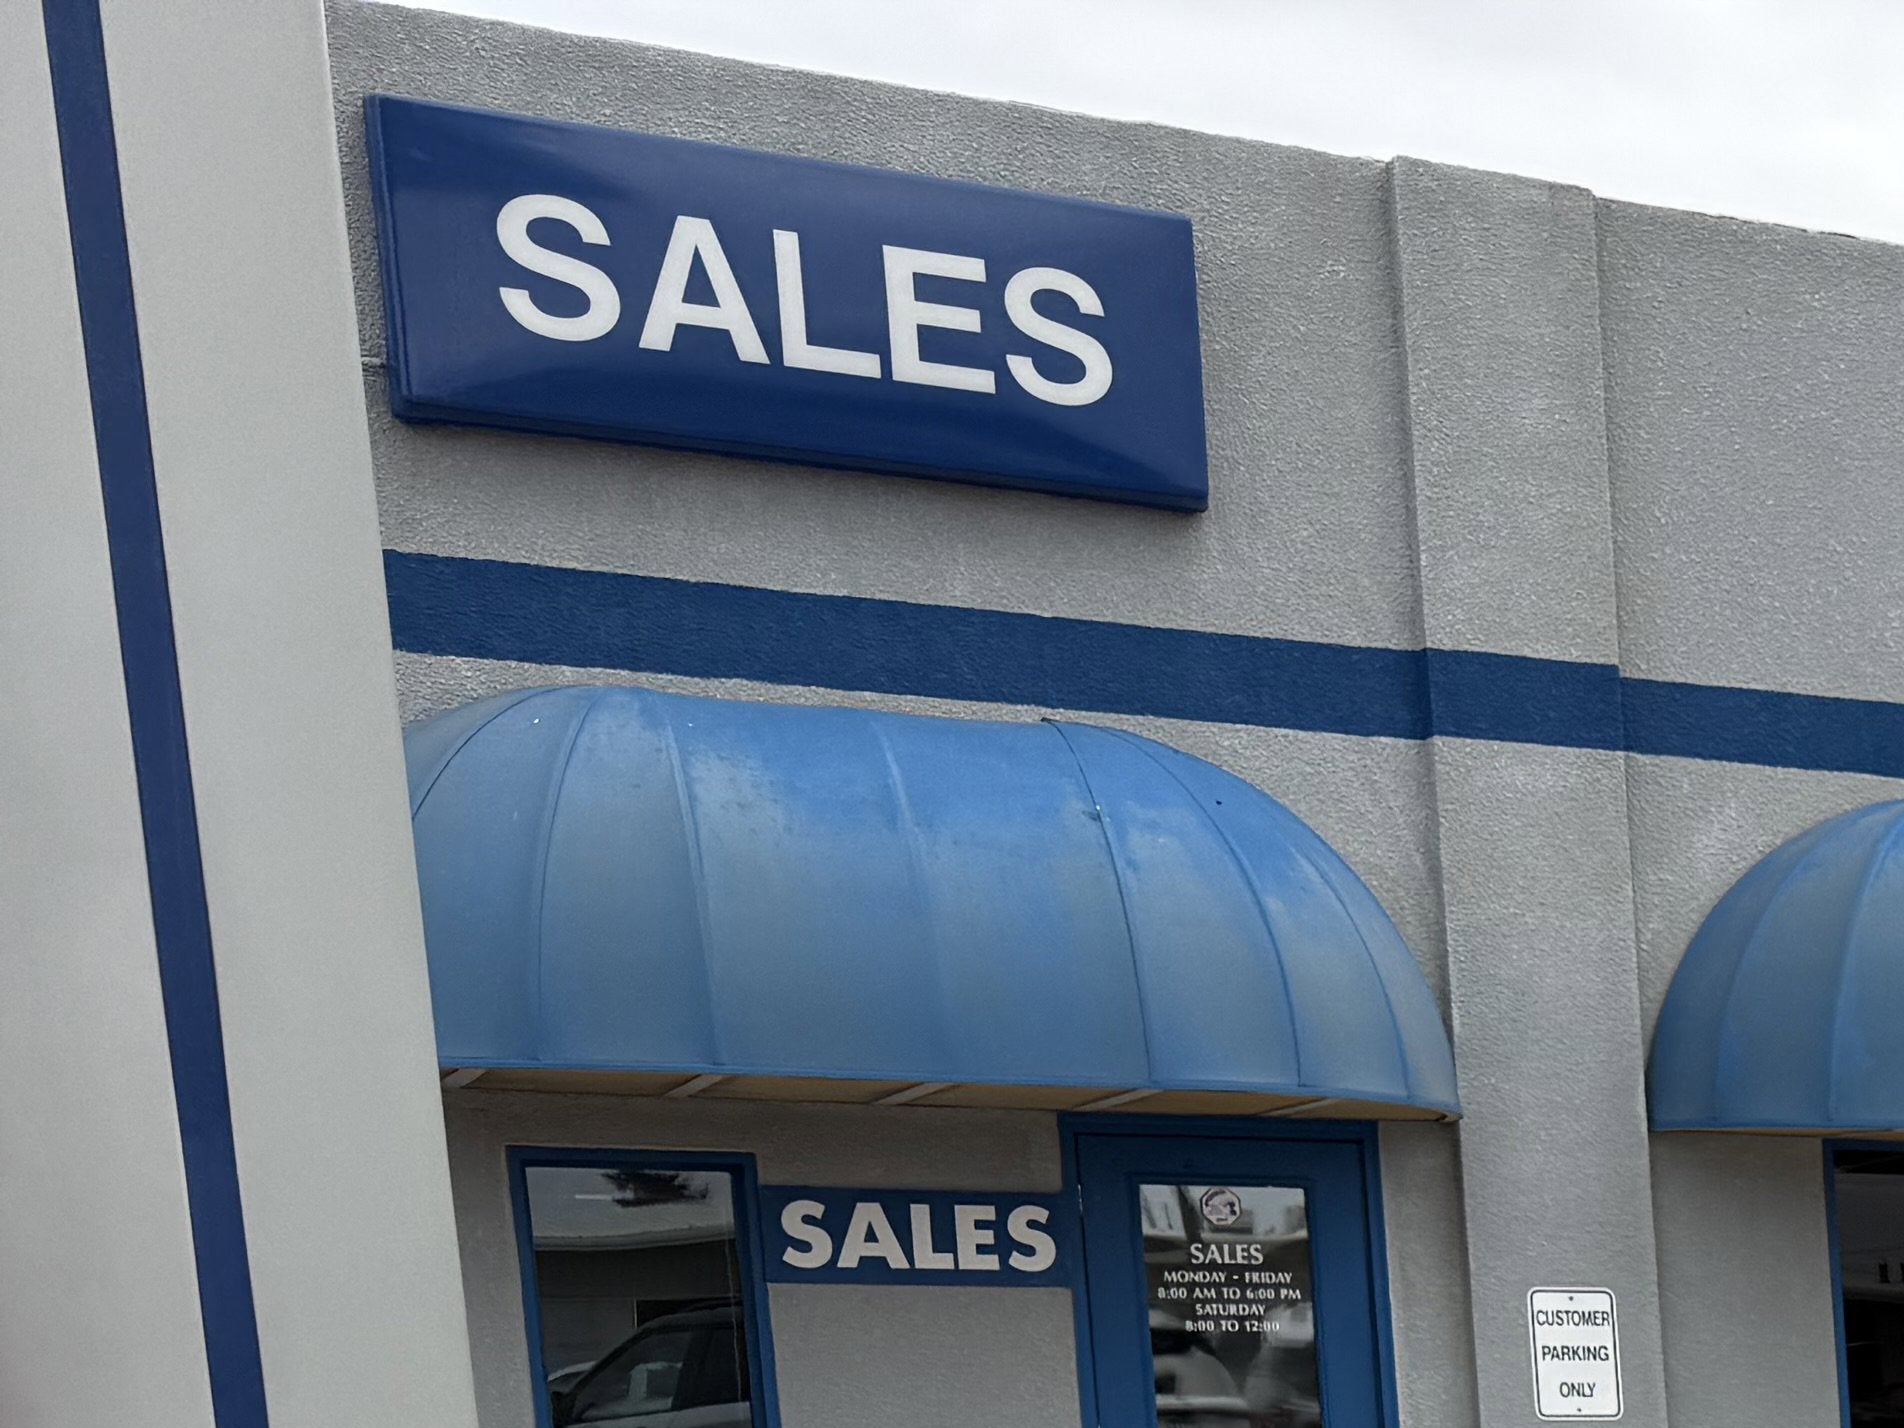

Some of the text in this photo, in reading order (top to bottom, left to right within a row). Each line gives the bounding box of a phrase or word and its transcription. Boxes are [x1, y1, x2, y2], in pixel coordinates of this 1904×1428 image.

[495, 193, 1113, 406] SALES
[781, 1199, 1057, 1272] SALES
[1190, 1243, 1264, 1265] SALES
[1163, 1270, 1226, 1283] MONDAY
[1244, 1271, 1292, 1284] FRIDAY
[1157, 1286, 1187, 1299] 8:00
[1193, 1286, 1216, 1299] AM
[1221, 1287, 1240, 1300] TO
[1280, 1288, 1301, 1300] PM
[1195, 1303, 1265, 1316] SATURDAY
[1185, 1320, 1280, 1332] 8:00 TO 12:00
[1536, 1310, 1610, 1326] CUSTOMER
[1542, 1345, 1609, 1361] PARKING
[1559, 1381, 1595, 1397] ONLY
